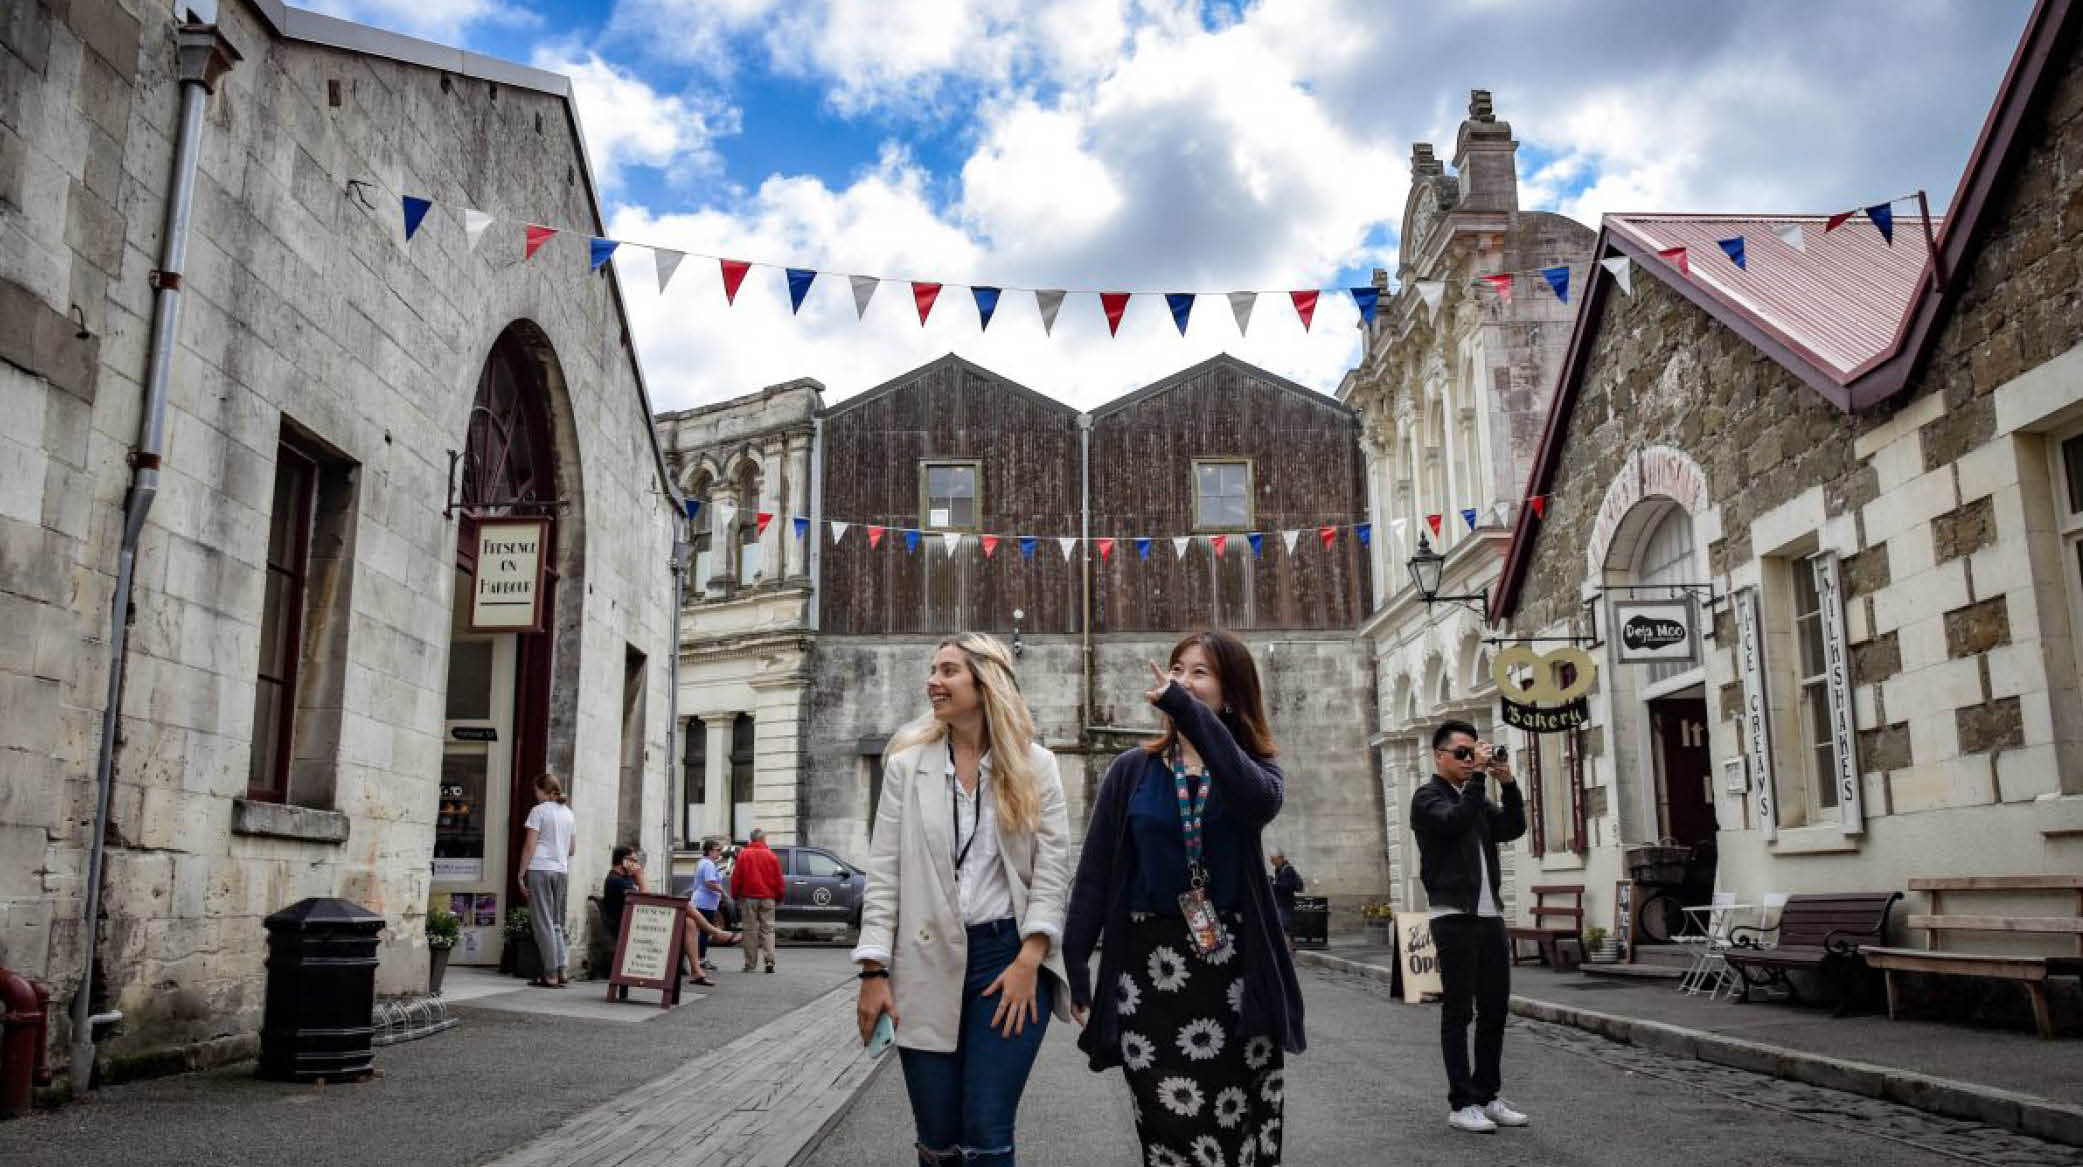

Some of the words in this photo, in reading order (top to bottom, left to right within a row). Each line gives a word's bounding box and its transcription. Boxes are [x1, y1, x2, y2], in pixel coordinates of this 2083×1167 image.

[484, 539, 536, 555] PRESENCE
[501, 560, 517, 572] ON
[480, 578, 531, 595] HARBOUR
[1823, 577, 1853, 801] MILKSHAKES
[1507, 704, 1582, 730] Bakery
[1750, 694, 1769, 817] CREAMS
